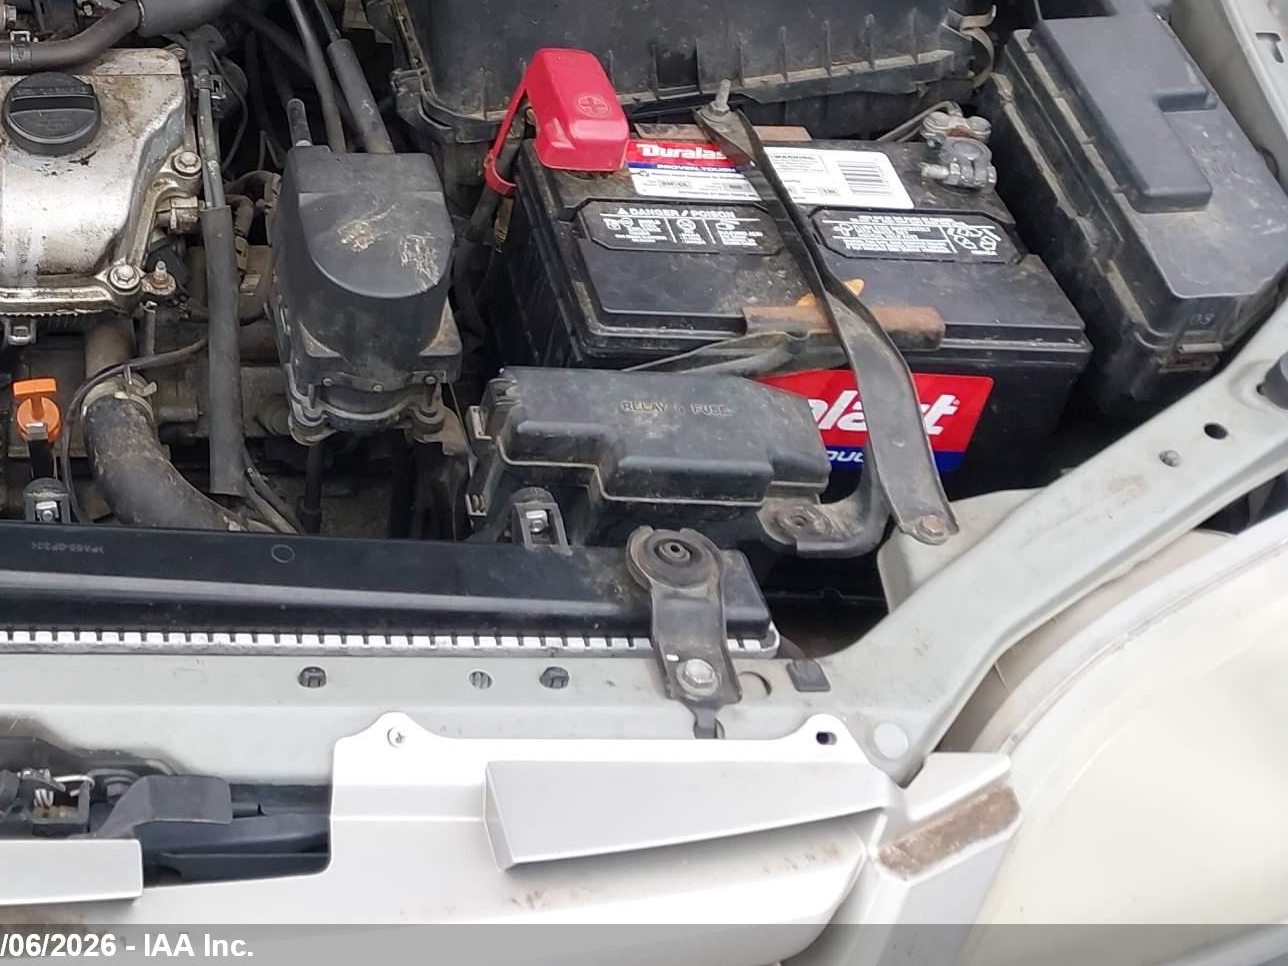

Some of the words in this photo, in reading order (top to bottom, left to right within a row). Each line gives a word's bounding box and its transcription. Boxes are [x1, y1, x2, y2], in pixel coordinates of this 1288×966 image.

[636, 143, 727, 160] Duralas
[629, 207, 680, 217] DANGER
[691, 209, 736, 219] POISON
[621, 400, 666, 413] RELAY
